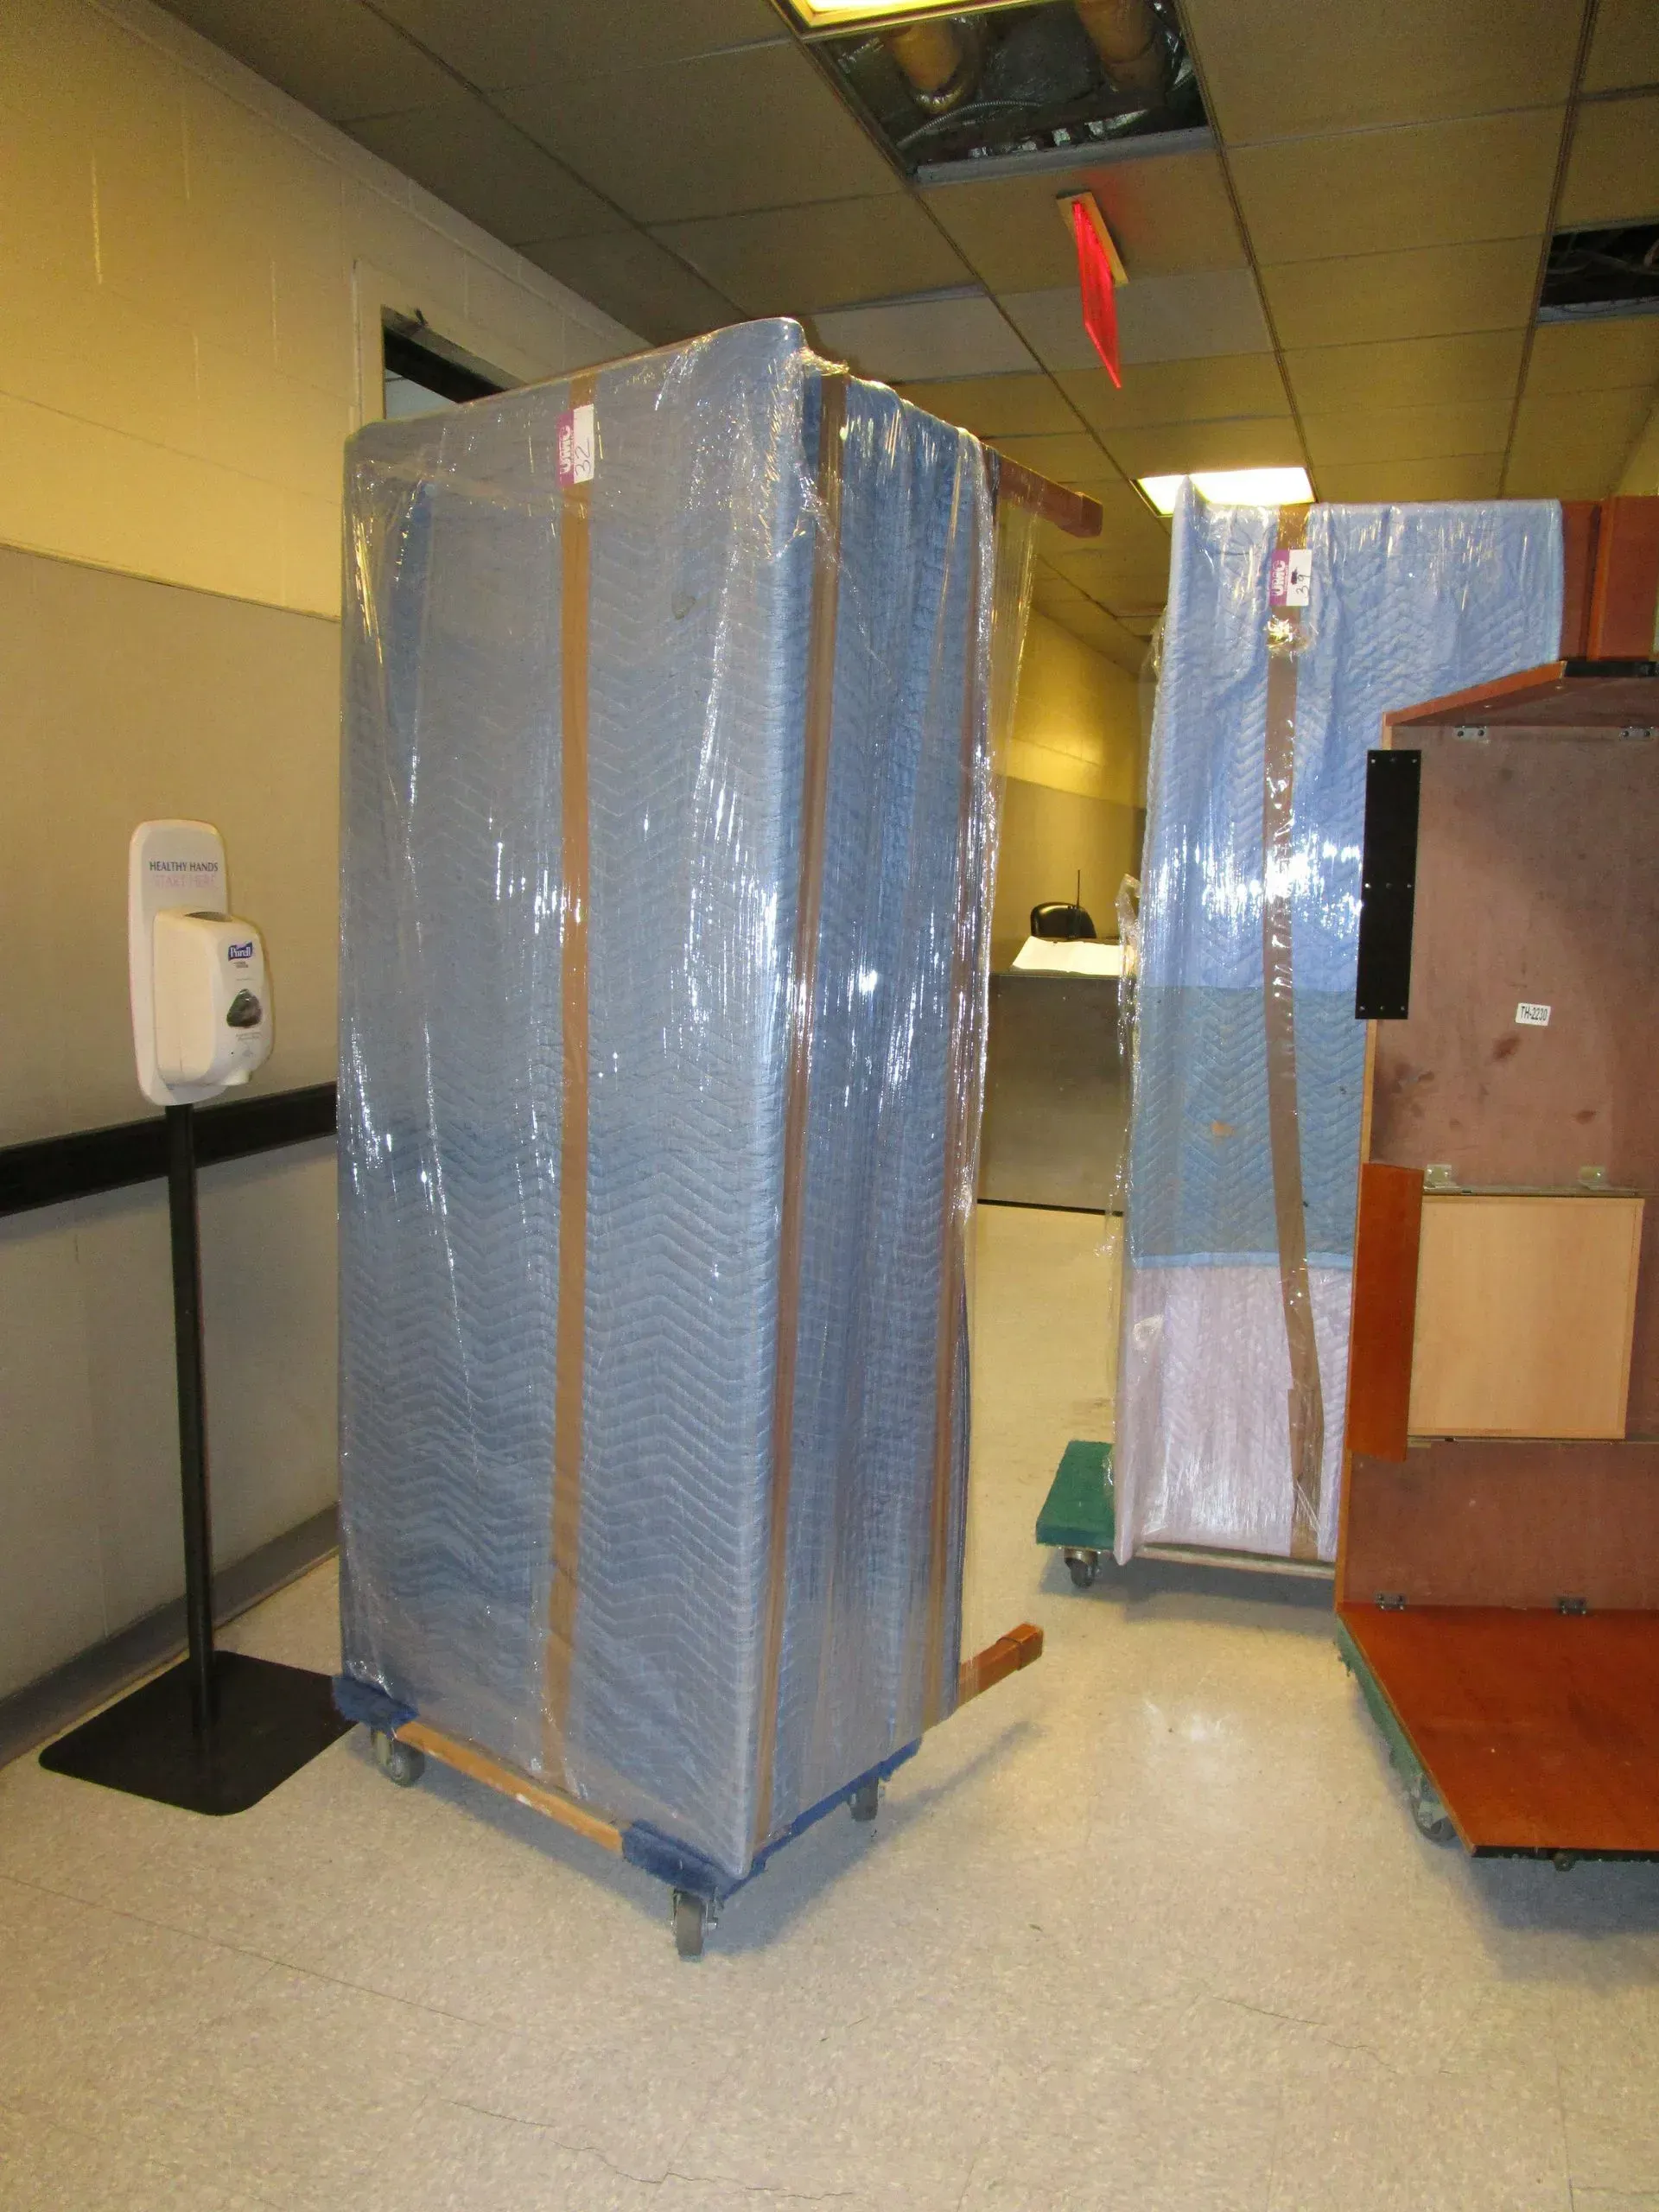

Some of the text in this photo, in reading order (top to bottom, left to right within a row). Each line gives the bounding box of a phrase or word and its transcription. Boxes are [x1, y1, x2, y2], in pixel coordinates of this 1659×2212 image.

[575, 437, 591, 475] 32
[1272, 560, 1286, 596] UMC
[149, 861, 219, 872] HEALTHY HANDS
[1521, 1006, 1548, 1021] TH-2230
